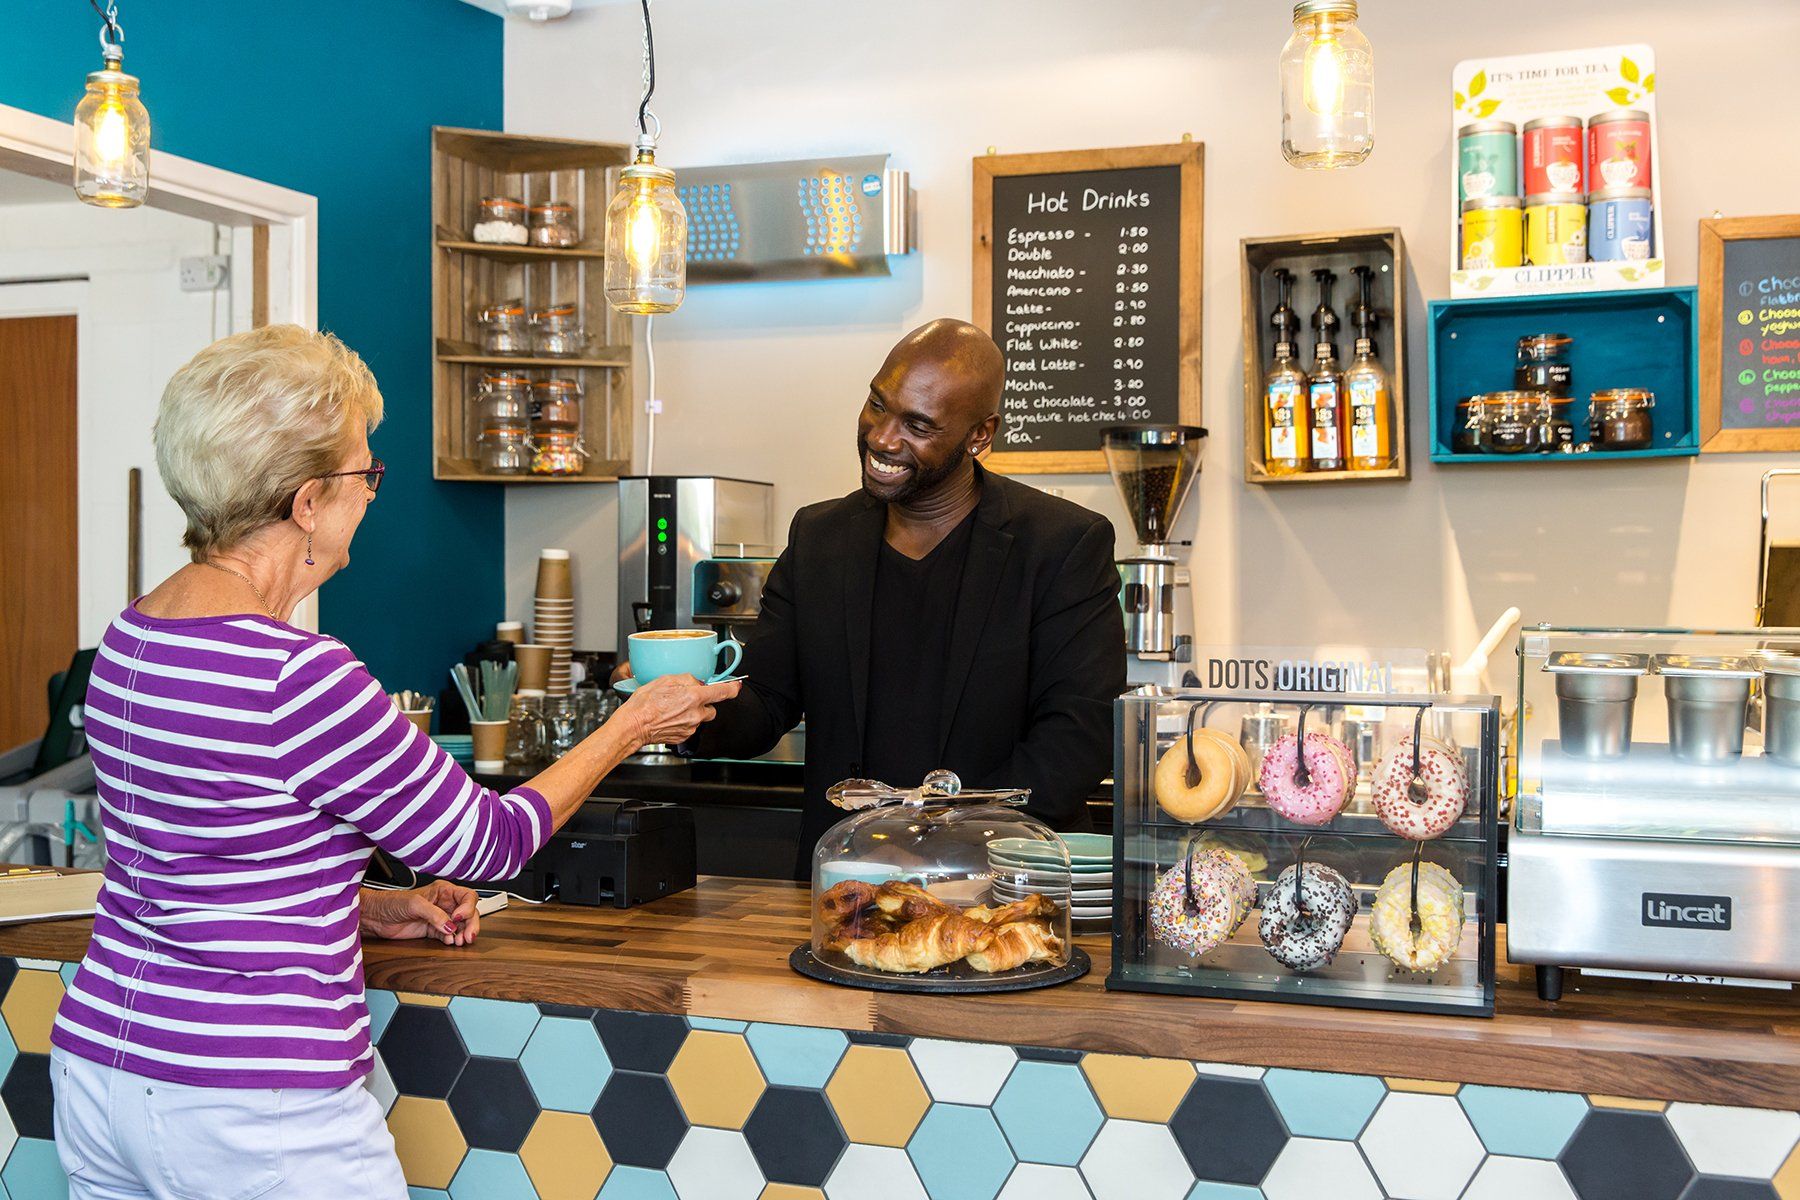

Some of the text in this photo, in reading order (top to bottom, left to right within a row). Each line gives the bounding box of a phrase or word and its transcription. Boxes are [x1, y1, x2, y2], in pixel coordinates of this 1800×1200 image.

[1518, 69, 1548, 80] TIME
[1555, 66, 1579, 77] FOR
[1585, 63, 1609, 74] TEA
[1027, 188, 1150, 214] Hot Drinks
[1007, 227, 1075, 249] Espresso
[1119, 226, 1149, 238] 1.50
[1007, 242, 1149, 262] Double 2.00
[1007, 266, 1075, 280] Macchiato
[1116, 263, 1149, 276] 2.30
[1514, 266, 1595, 284] CLIPPER
[1006, 285, 1071, 297] Americano
[1114, 299, 1147, 312] 2.90
[1006, 338, 1034, 352] Flat
[1006, 358, 1037, 373] Iced
[1113, 358, 1144, 370] 2.90
[1004, 398, 1029, 410] Hot
[1033, 395, 1096, 409] chocolate
[1113, 395, 1147, 408] 3.00
[1004, 409, 1151, 432] Signature hot choc 4.00
[1277, 659, 1399, 694] ORIGINAL
[1646, 899, 1727, 924] Lincat
